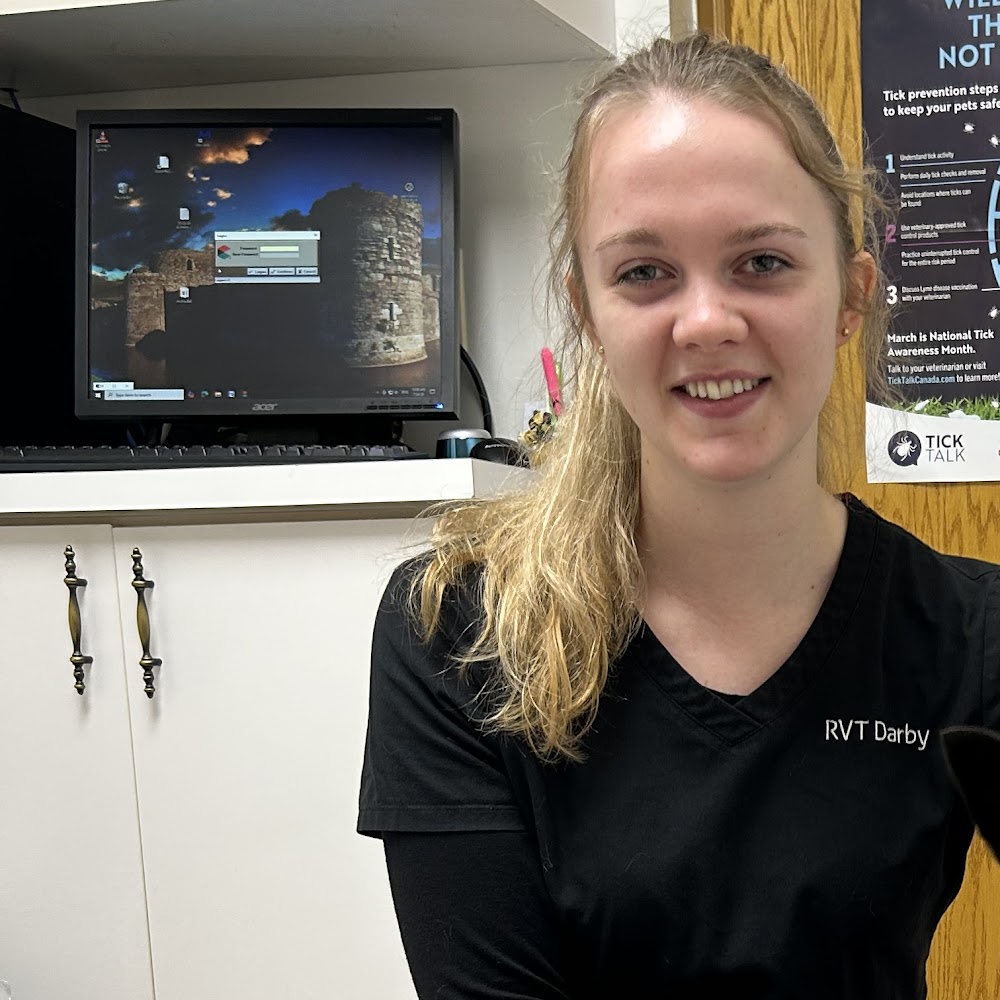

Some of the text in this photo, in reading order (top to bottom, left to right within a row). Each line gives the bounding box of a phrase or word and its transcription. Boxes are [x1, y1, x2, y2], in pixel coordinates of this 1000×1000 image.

[938, 44, 996, 70] NOT
[882, 84, 998, 102] Tick prevention steps
[882, 106, 896, 116] to
[898, 104, 924, 116] keep
[926, 104, 952, 116] your
[954, 100, 978, 114] pets
[886, 154, 896, 174] 1
[968, 168, 986, 176] removal
[886, 224, 896, 242] 2
[886, 286, 898, 304] 3
[886, 328, 994, 342] March is National Tick
[888, 344, 976, 356] Awareness Month.
[888, 364, 900, 372] Talk
[902, 364, 910, 372] to
[910, 364, 924, 374] your
[924, 362, 964, 372] veterinarian
[972, 362, 986, 370] visit
[888, 372, 1000, 384] TickTalkCanada.com to learn more!
[252, 402, 278, 412] acer
[926, 434, 964, 448] TICK
[928, 450, 966, 462] TALK
[826, 720, 930, 750] RVT Darby
